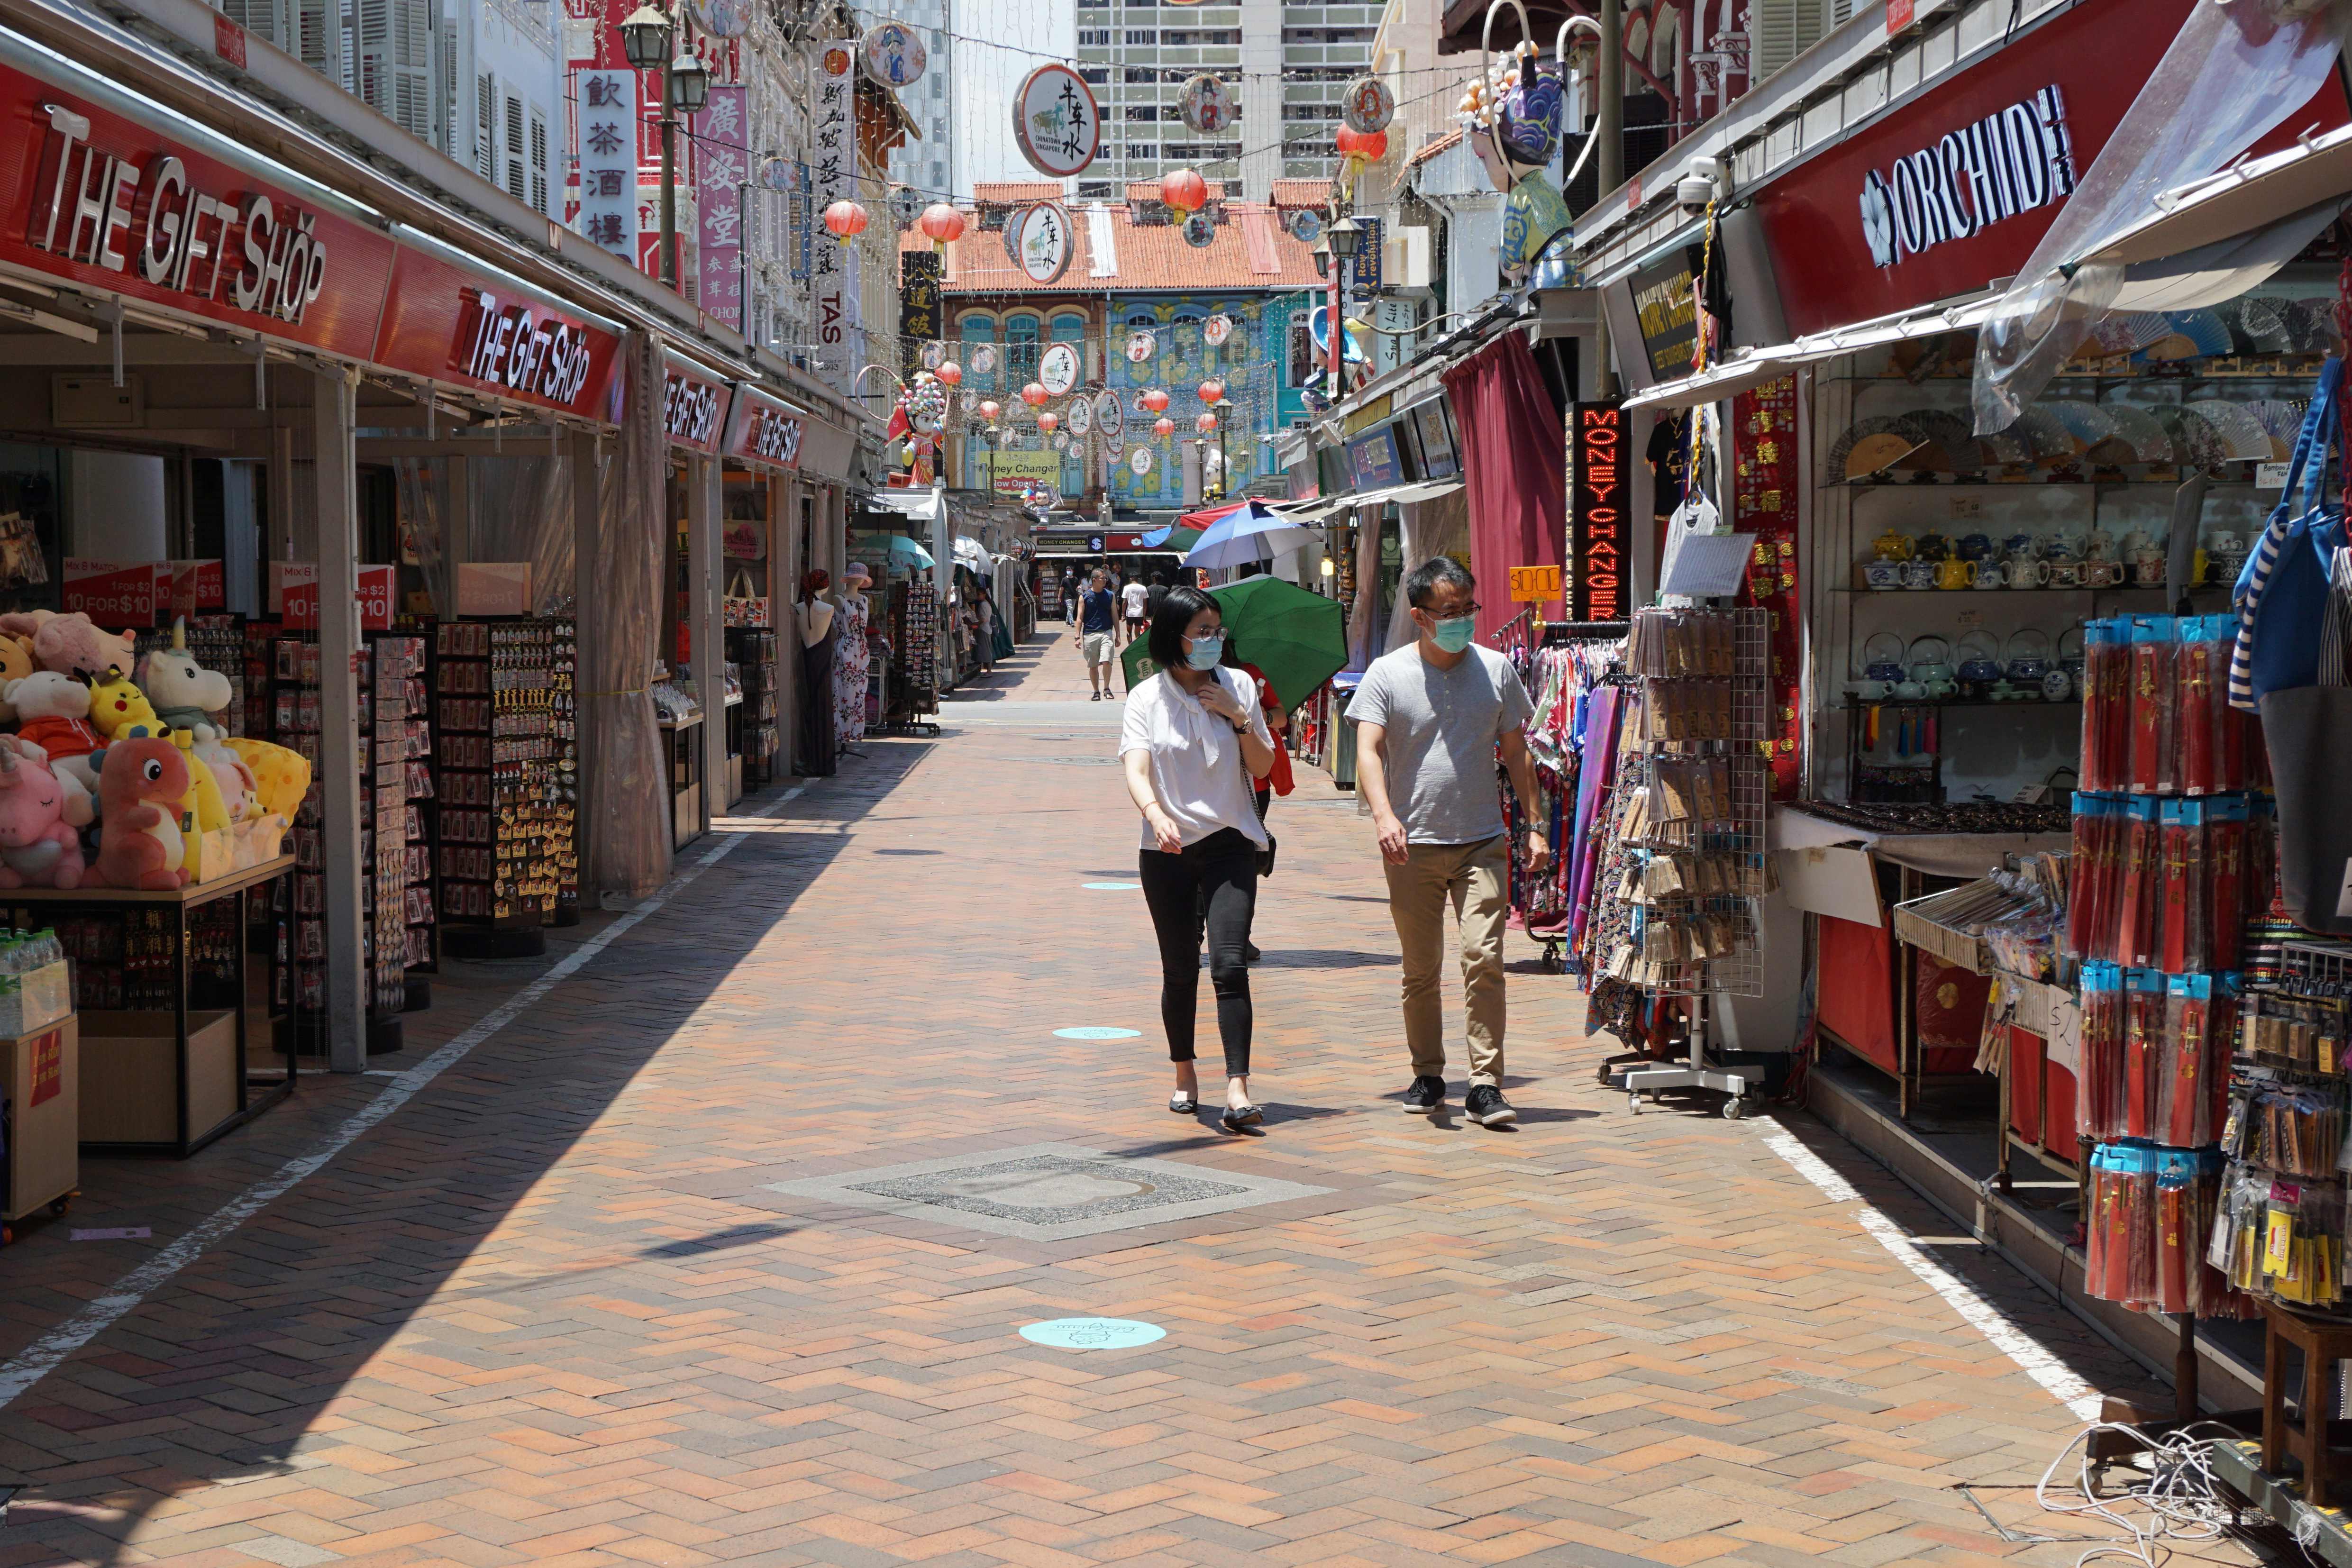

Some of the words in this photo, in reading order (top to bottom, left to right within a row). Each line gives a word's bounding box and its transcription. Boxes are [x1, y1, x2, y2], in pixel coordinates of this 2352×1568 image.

[1058, 77, 1087, 162] 牛车水
[585, 75, 627, 245] 飲茶酒樓
[1035, 135, 1061, 145] CHINATOWN
[1035, 143, 1061, 153] SINGAPORE
[702, 96, 744, 248] 廣安堂
[1893, 100, 2053, 253] ORCHID
[45, 105, 140, 272] THE
[143, 156, 238, 301] GIFT
[232, 195, 326, 326] SHOP
[1042, 210, 1058, 272] 牛车水
[1367, 223, 1377, 276] revolution
[1358, 254, 1366, 277] Row
[710, 307, 740, 319] CHOP
[821, 291, 841, 344] TAS
[1384, 303, 1396, 323] Lite
[1660, 270, 1696, 330] CHANGE
[469, 292, 512, 383] THE
[507, 311, 552, 392] GIFT
[544, 324, 589, 406] SHOP
[1056, 349, 1070, 389] 牛车水
[665, 368, 676, 431] HE
[671, 377, 697, 437] GIFT
[691, 384, 717, 444] SHOP
[757, 408, 771, 455] THE
[768, 415, 787, 458] GIFT
[784, 419, 800, 462] SHOP
[1015, 464, 1058, 474] Changer
[1584, 410, 1620, 502] MONEY
[1012, 480, 1034, 489] Open
[65, 561, 80, 570] MIX
[81, 561, 88, 570] &
[91, 562, 119, 572] MATCH
[284, 567, 301, 576] MIX
[304, 568, 311, 577] &
[1584, 508, 1621, 621] CHANGER
[66, 593, 84, 611] 10
[87, 597, 118, 612] FOR
[119, 594, 151, 614] $10
[111, 582, 116, 590] 1
[119, 583, 135, 592] FOR
[137, 582, 151, 593] $2
[197, 584, 221, 598] $10
[370, 585, 385, 596] $2
[287, 599, 307, 617] 10
